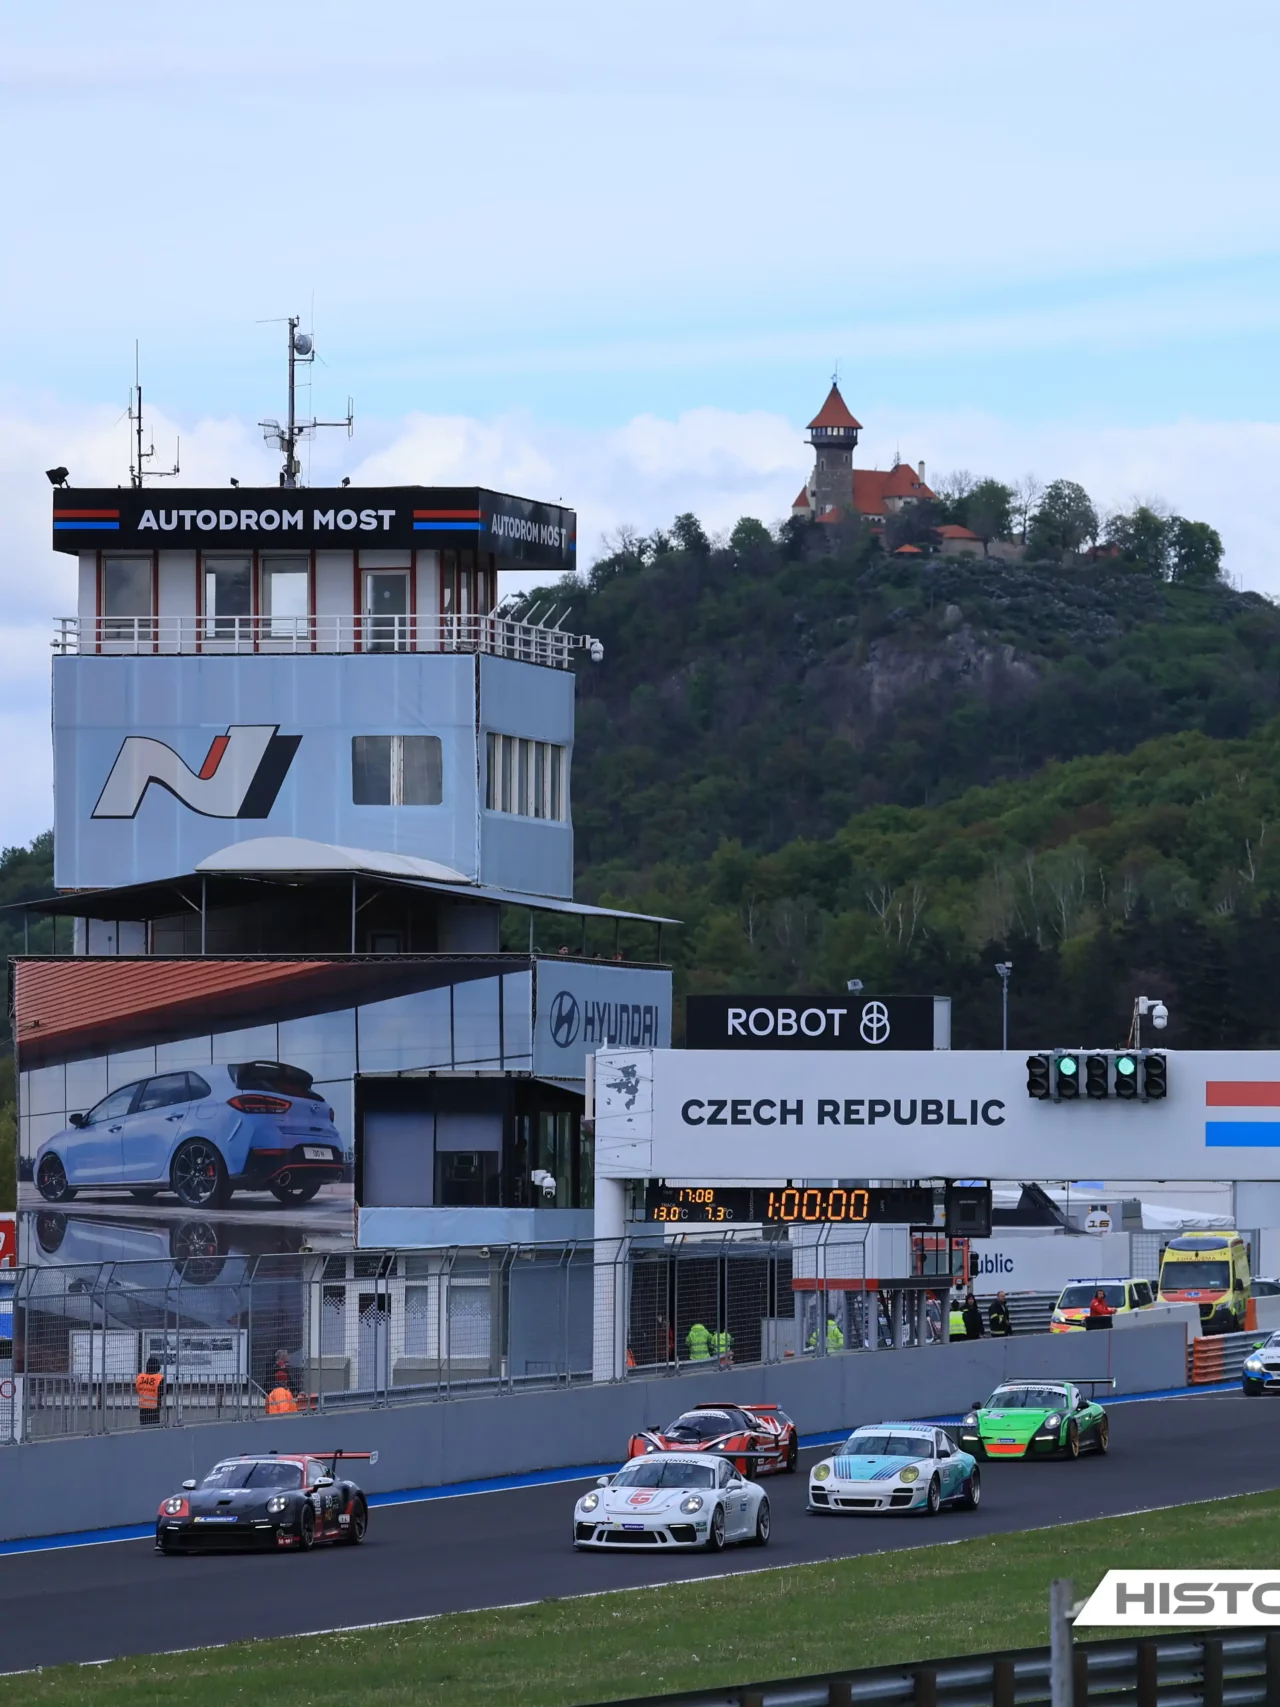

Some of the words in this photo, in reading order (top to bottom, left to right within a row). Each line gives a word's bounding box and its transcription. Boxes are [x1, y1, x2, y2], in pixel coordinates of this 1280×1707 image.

[138, 509, 304, 531] AUTODROM
[313, 509, 396, 531] MOST
[491, 513, 539, 544] AUTODROM
[540, 523, 567, 549] MOST
[583, 1000, 659, 1047] HYUNDAI
[727, 1007, 848, 1037] ROBOT
[681, 1098, 804, 1126] CZECH
[817, 1098, 1006, 1126] REPUBLIC
[679, 1189, 714, 1203] 17:08
[768, 1190, 869, 1221] 1:00:00
